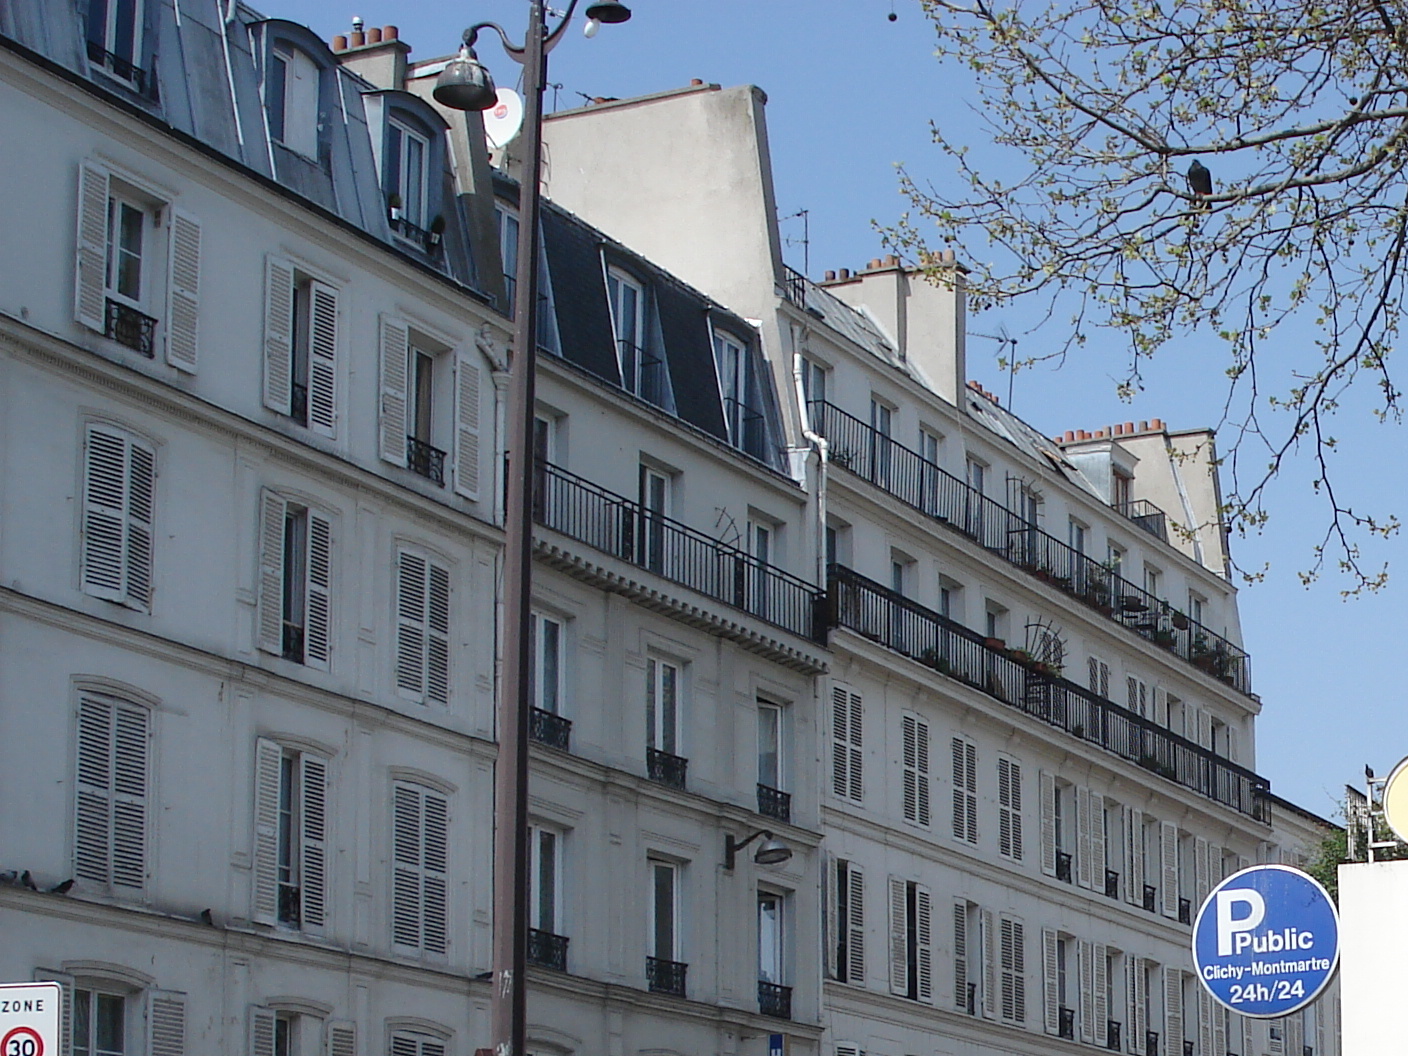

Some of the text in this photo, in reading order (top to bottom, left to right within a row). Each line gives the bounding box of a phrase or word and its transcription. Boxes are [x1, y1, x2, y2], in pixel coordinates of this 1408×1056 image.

[1216, 888, 1314, 957] P Public
[1203, 957, 1330, 980] Clichy-Montmartre
[1230, 980, 1305, 1004] 24h/24
[1, 1000, 44, 1013] ZONE
